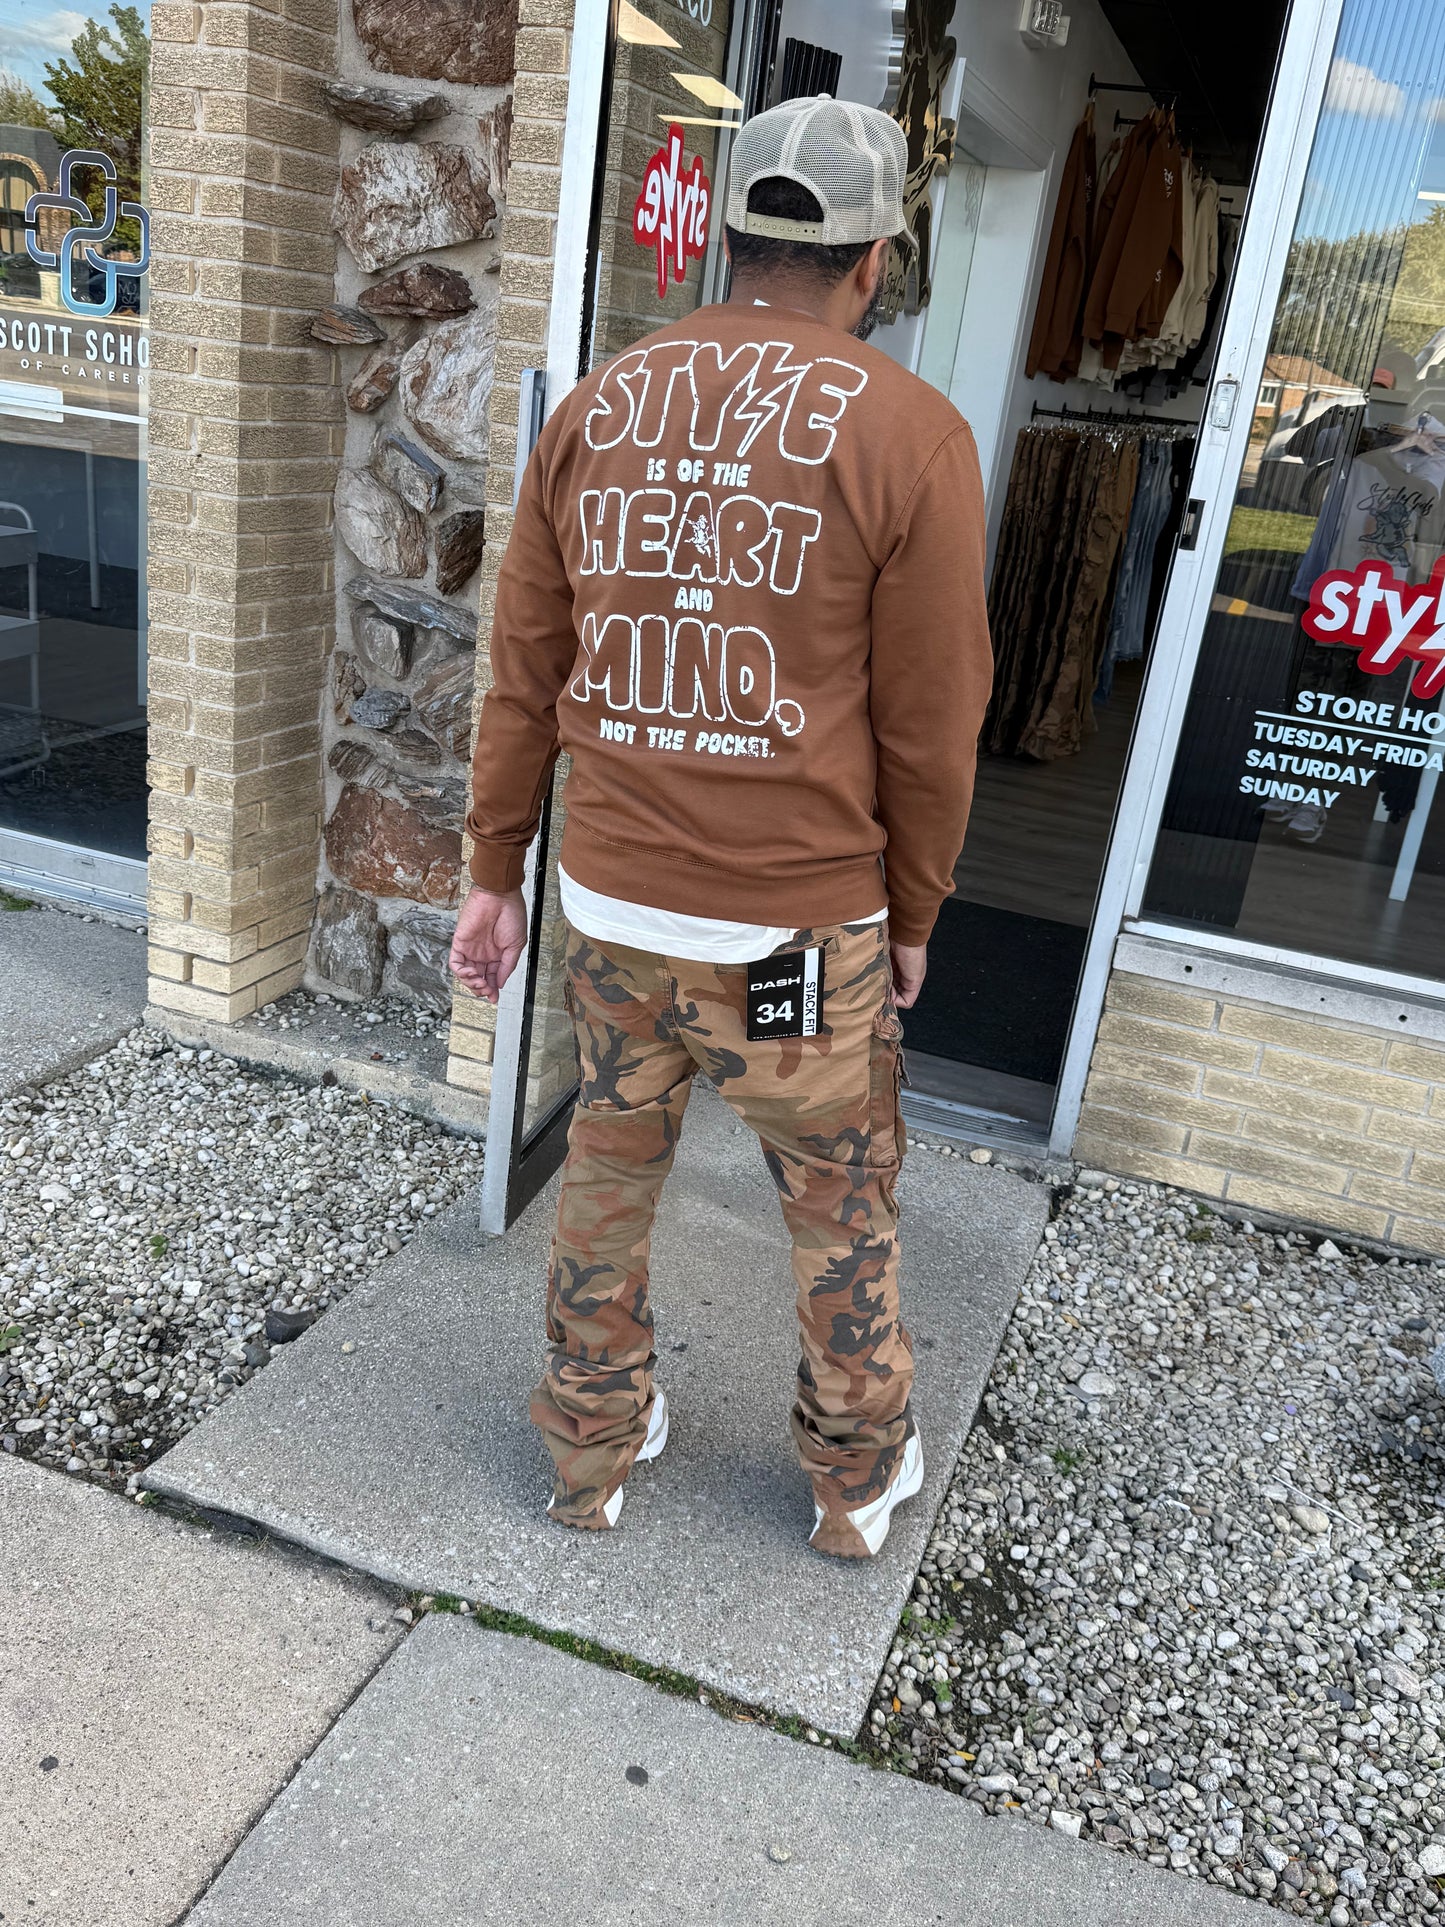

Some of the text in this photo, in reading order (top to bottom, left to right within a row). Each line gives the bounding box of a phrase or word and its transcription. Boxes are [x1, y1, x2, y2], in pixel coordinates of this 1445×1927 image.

[20, 358, 43, 371] OF
[585, 341, 869, 466] STYLE
[646, 458, 752, 488] IS OF THE
[579, 487, 822, 596] HEART
[674, 587, 714, 612] AND
[1296, 690, 1395, 727] STORE
[599, 718, 776, 758] NOT THE POCKET.
[1245, 749, 1376, 787] SATURDAY
[1239, 776, 1340, 809] SUNDAY
[750, 975, 801, 992] DASH
[756, 1000, 795, 1024] 34
[804, 981, 817, 1034] STACK FIT
